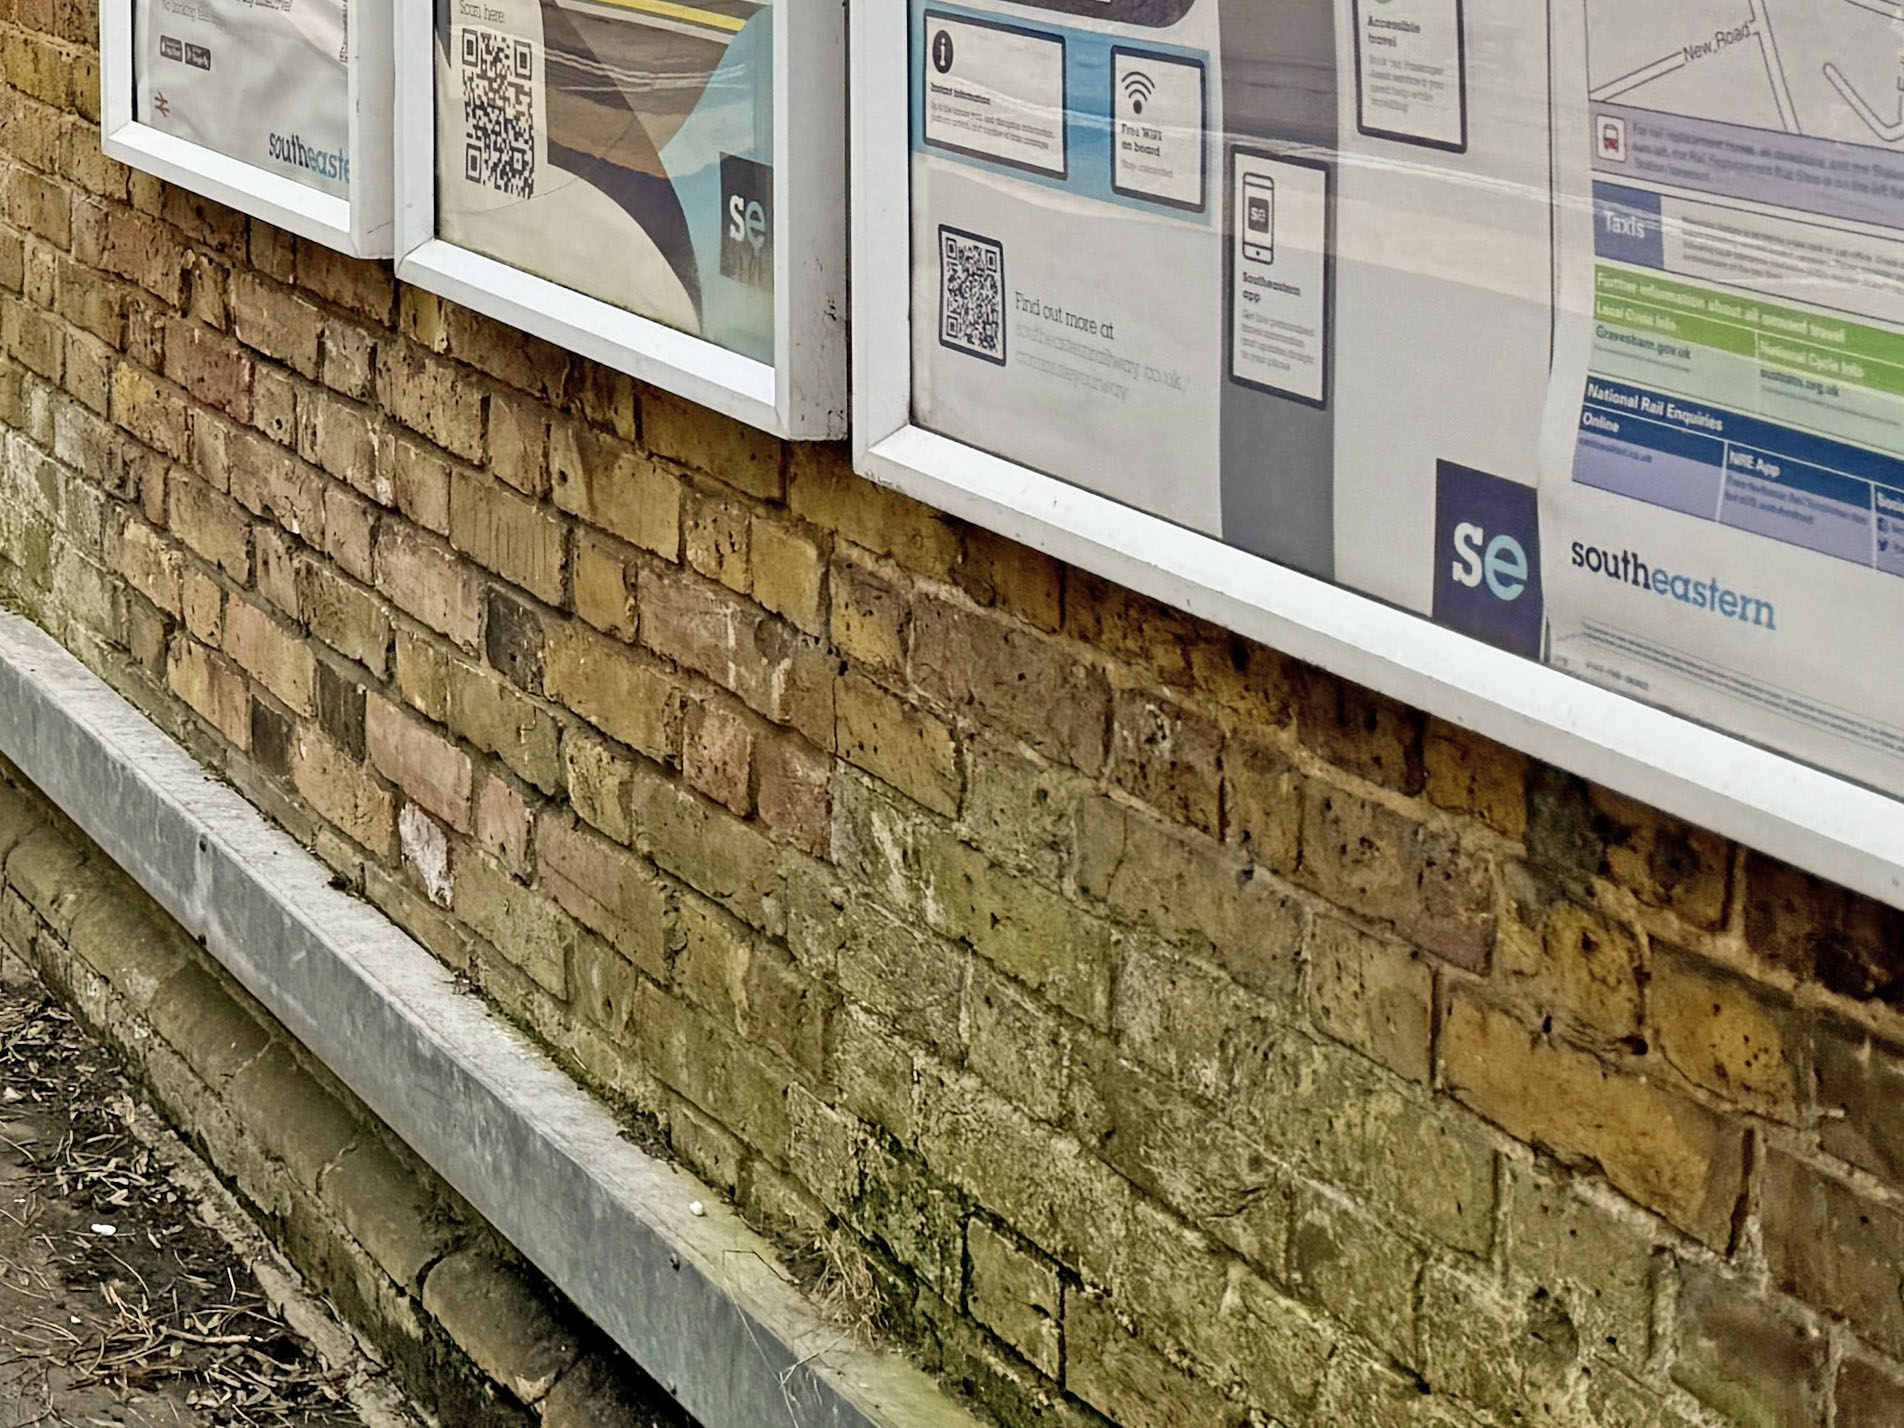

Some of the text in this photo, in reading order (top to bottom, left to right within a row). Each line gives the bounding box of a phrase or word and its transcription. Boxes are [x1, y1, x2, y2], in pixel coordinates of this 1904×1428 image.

[1683, 23, 1750, 61] New Road
[730, 195, 765, 248] se
[1603, 211, 1645, 239] Taxis
[1016, 291, 1114, 340] Find out more at
[1595, 325, 1690, 360] Gravesham.gov.uk
[1583, 412, 1619, 432] Online
[1587, 383, 1723, 431] National Rail Enquiries
[1755, 457, 1781, 478] App
[1452, 520, 1527, 601] se
[1571, 542, 1776, 630] southeastern
